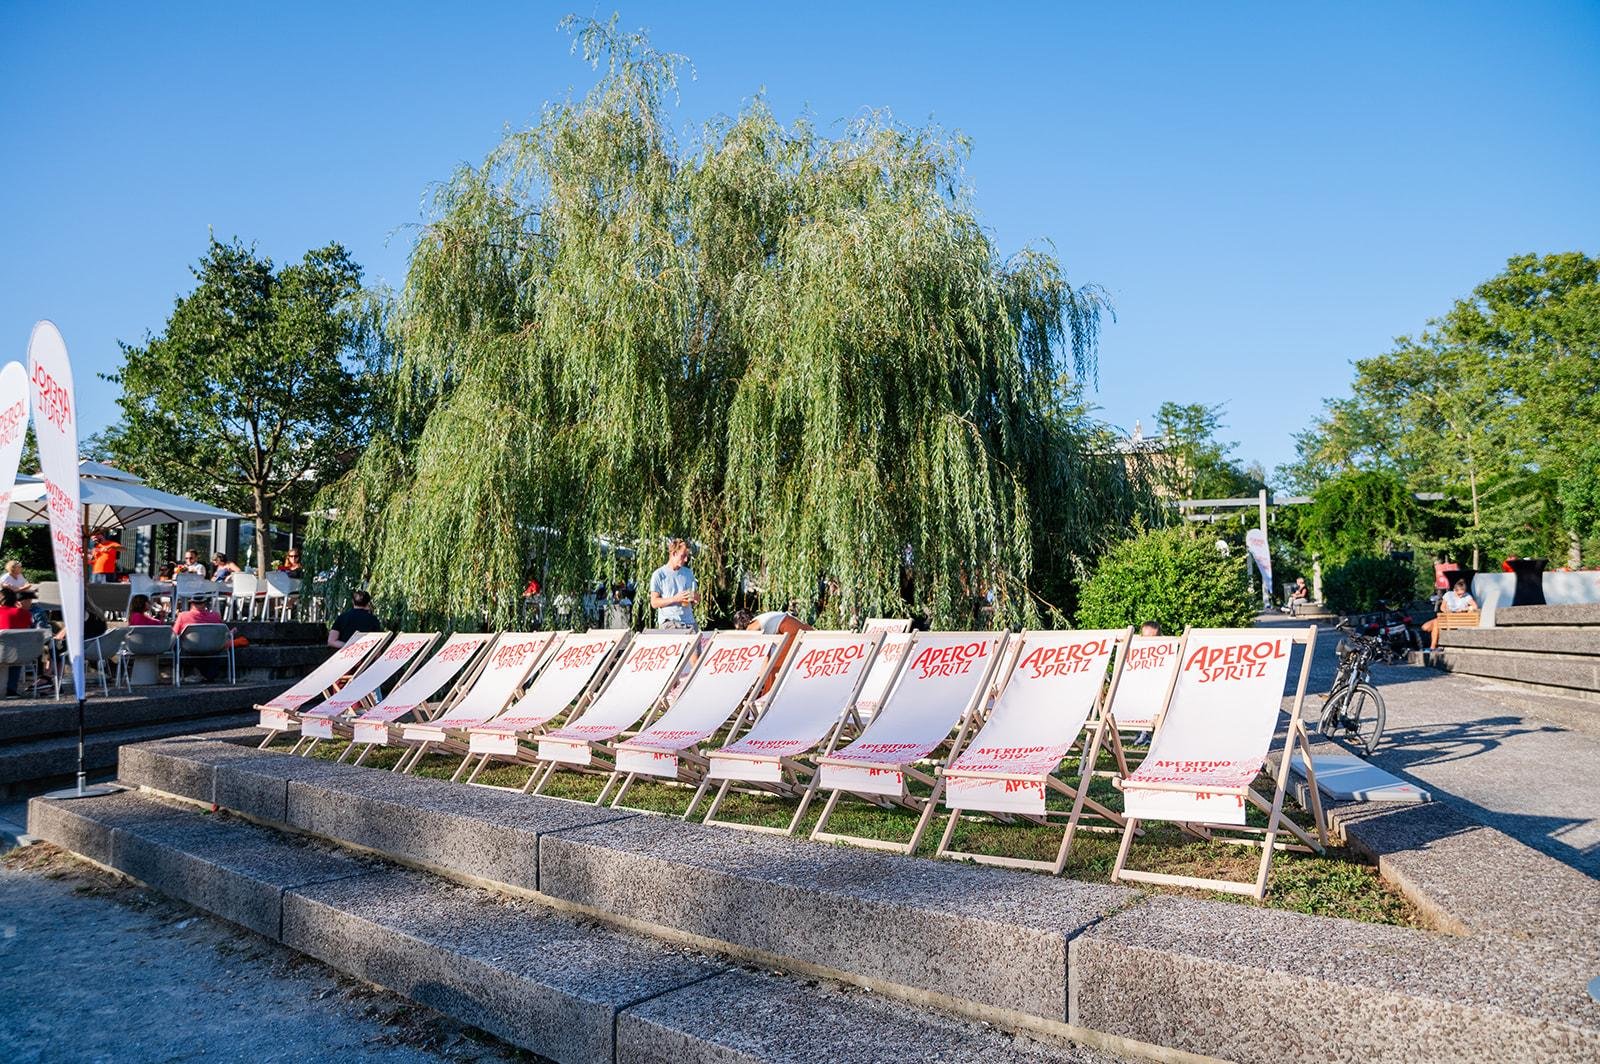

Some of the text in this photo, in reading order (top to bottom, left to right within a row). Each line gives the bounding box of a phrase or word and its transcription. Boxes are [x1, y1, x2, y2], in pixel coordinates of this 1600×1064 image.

[0, 398, 25, 430] PEROL
[0, 422, 19, 447] PRITZ
[492, 640, 537, 662] APEROL
[556, 641, 608, 662] APEROL
[627, 643, 682, 664] APEROL
[704, 643, 767, 666] APEROL
[796, 643, 865, 670] APEROL
[911, 640, 988, 670] APEROL
[1020, 639, 1109, 669] APEROL
[1184, 639, 1286, 671] APEROL
[495, 655, 526, 670] SPRITZ
[560, 656, 595, 670] SPRITZ
[631, 659, 669, 673] SPRITZ
[709, 659, 753, 675] SPRITZ
[803, 661, 851, 679] SPRITZ
[919, 659, 972, 680] SPRITZ
[1031, 658, 1091, 680] SPRITZ
[1126, 656, 1165, 672] SPRITZ
[1198, 661, 1268, 683] SPRITZ
[977, 746, 1045, 755] APERITIVO
[1155, 760, 1231, 768] APERITIVO
